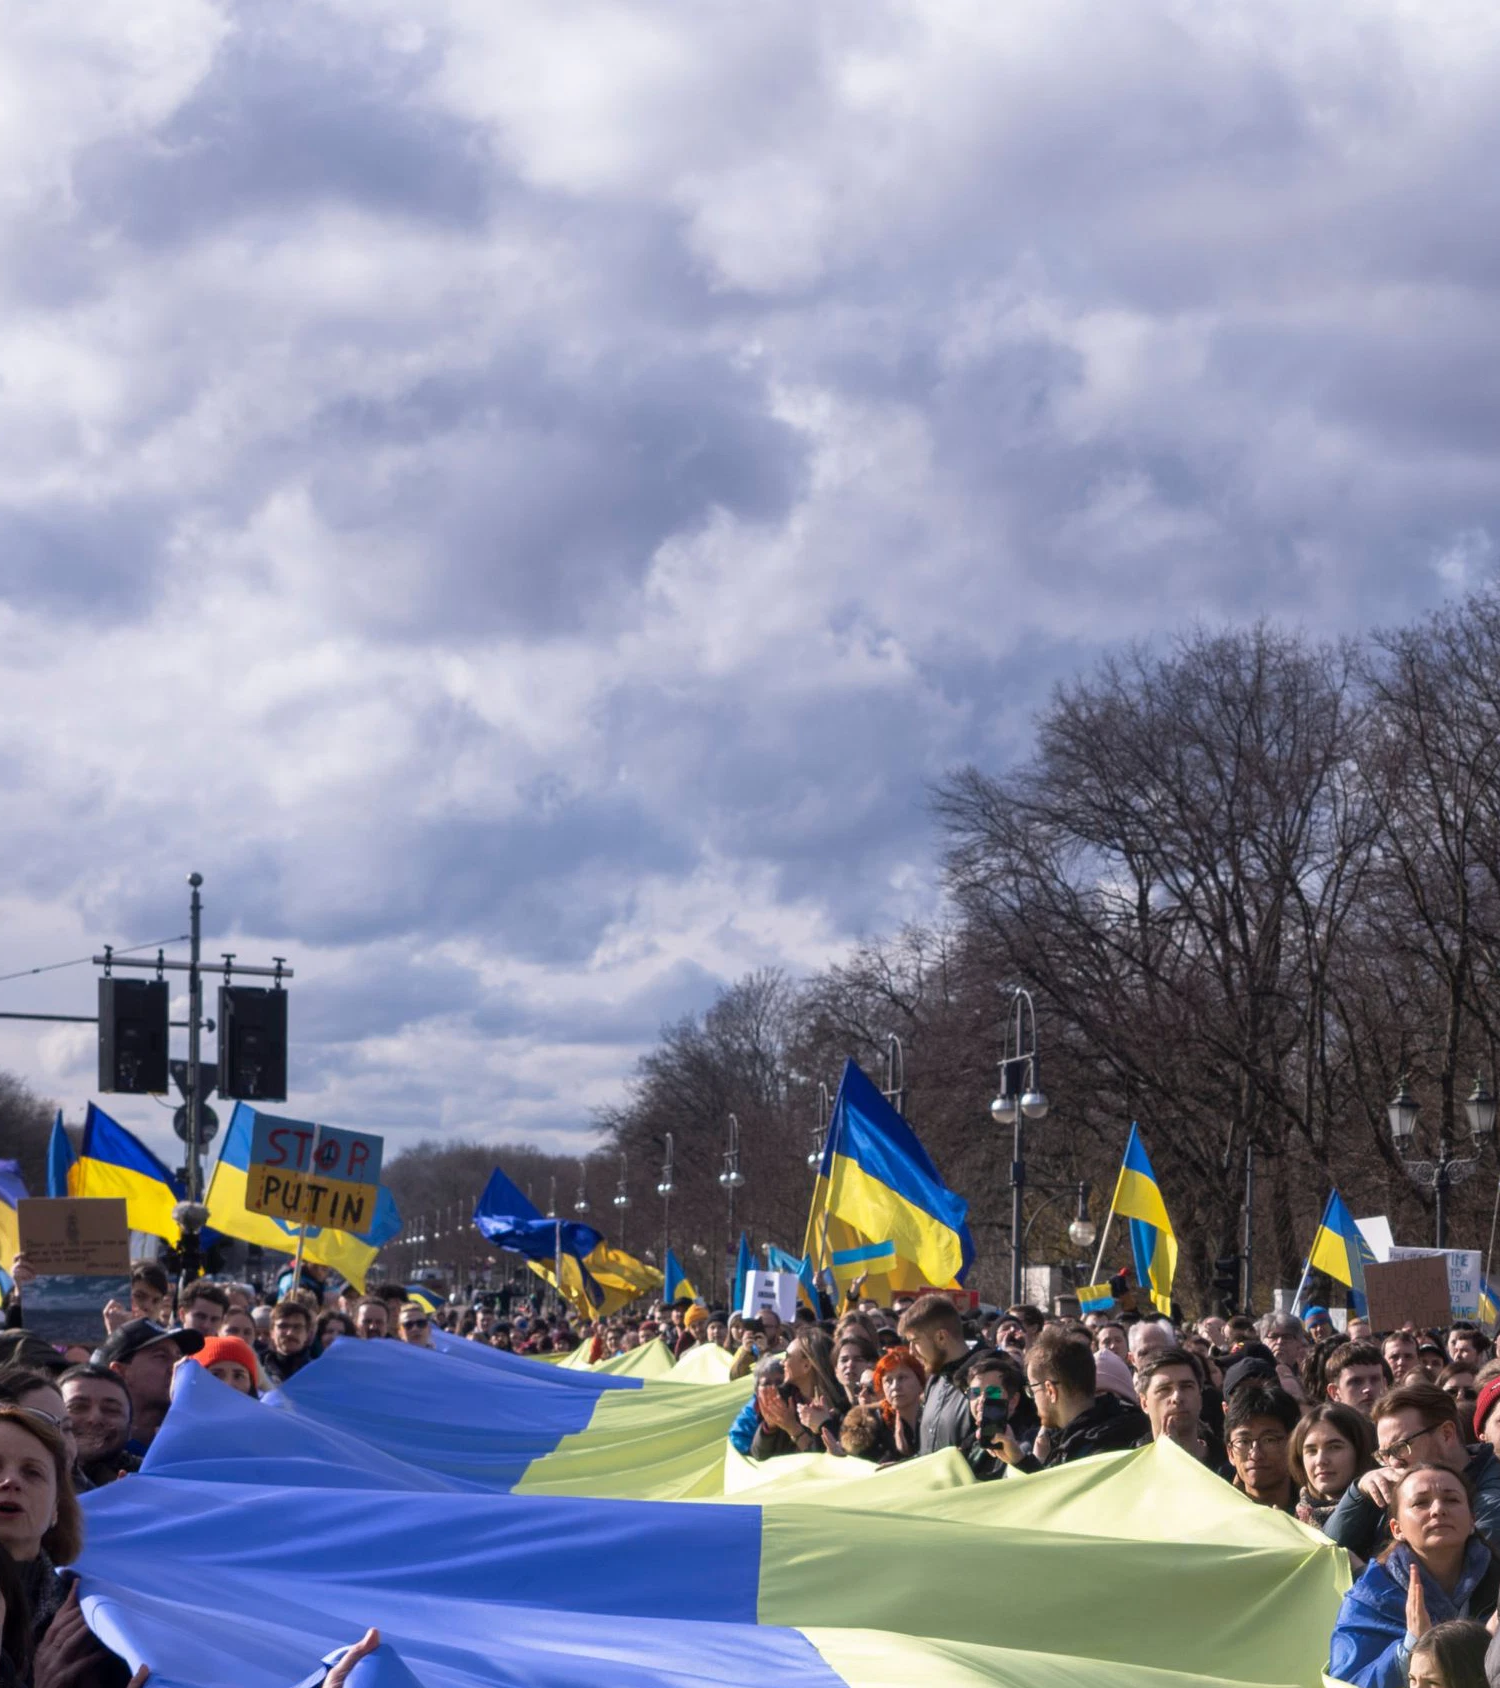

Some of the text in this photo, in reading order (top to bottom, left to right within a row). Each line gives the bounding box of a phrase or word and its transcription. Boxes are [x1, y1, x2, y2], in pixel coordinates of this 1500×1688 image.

[265, 1128, 370, 1176] STOP
[263, 1175, 365, 1225] PUTIN
[1450, 1280, 1471, 1293] STEN
